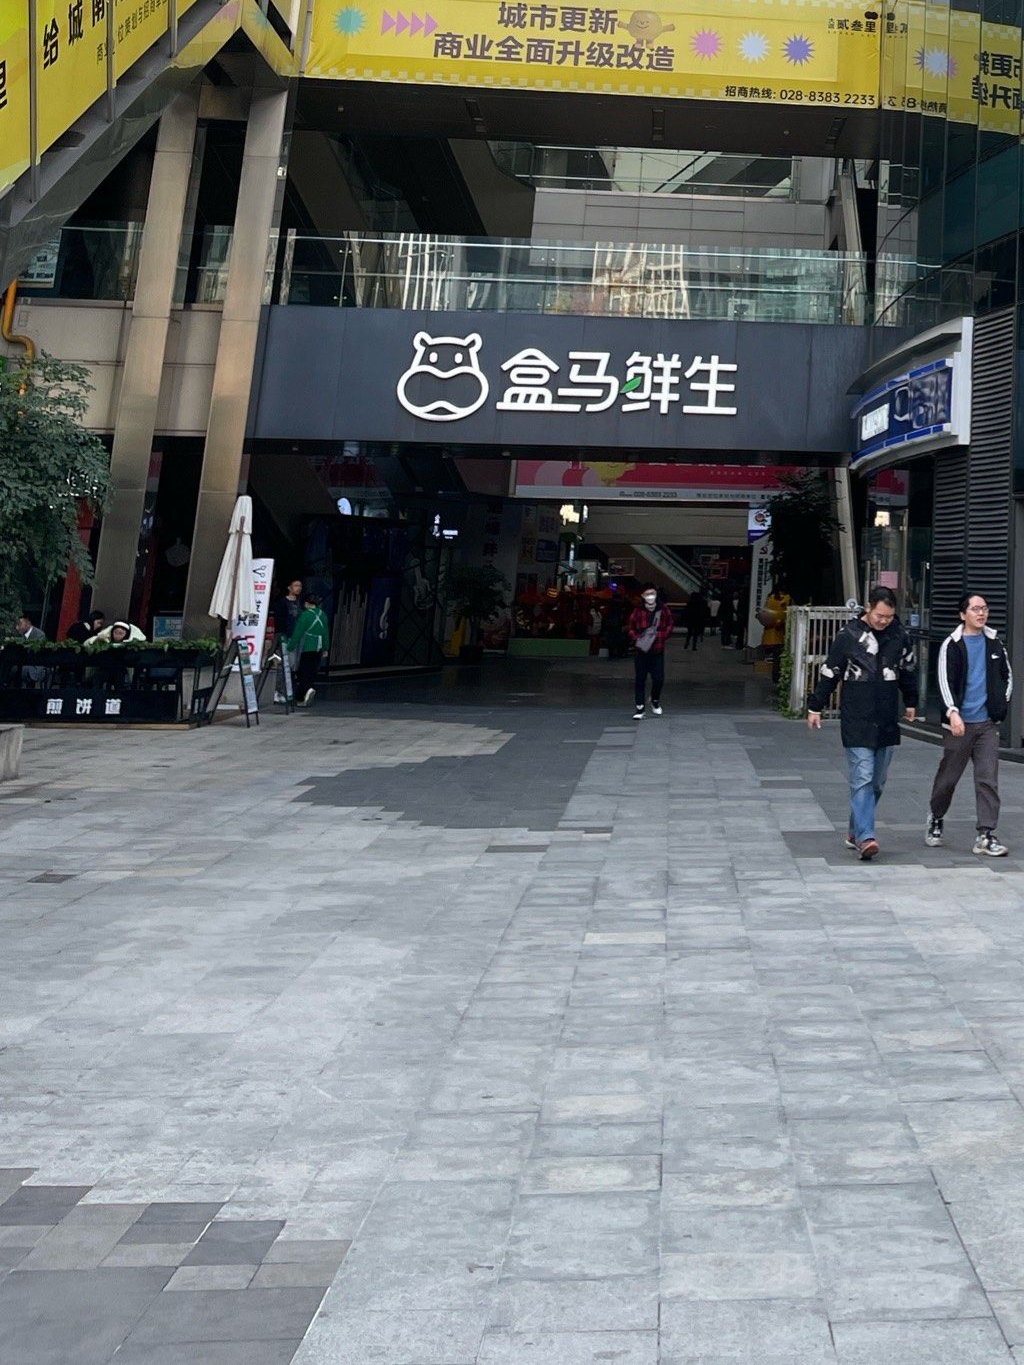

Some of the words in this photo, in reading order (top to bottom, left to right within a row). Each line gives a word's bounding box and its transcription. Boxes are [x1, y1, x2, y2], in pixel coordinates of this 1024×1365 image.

[497, 1, 618, 35] 城市更新
[433, 32, 675, 72] 商业全面升级改造
[780, 89, 840, 102] 028-8383
[844, 93, 875, 106] 2233
[495, 347, 738, 415] 盒马鲜生
